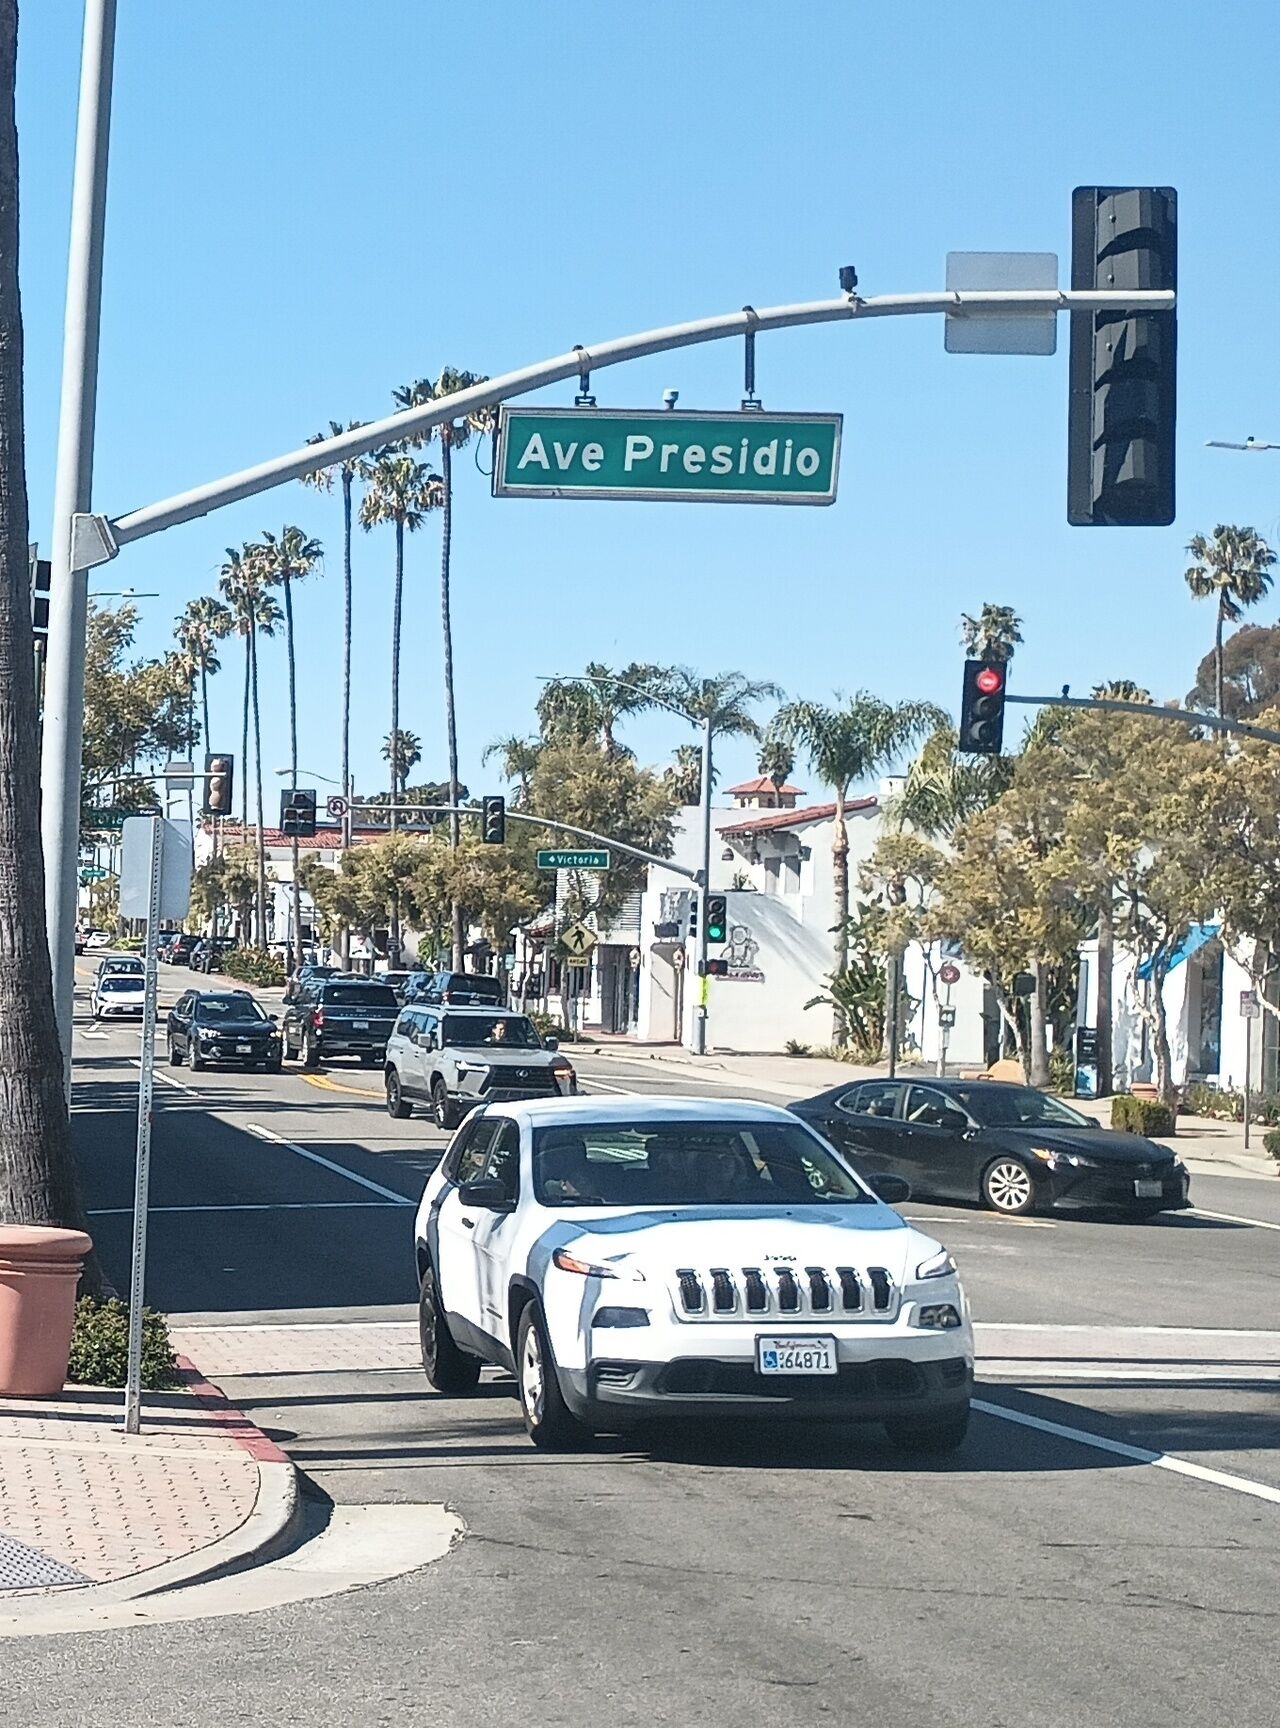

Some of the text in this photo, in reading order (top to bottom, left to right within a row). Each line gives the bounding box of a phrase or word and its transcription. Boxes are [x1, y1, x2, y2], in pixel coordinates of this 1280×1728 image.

[515, 433, 822, 478] Ave Presidio
[556, 854, 600, 865] Victoria
